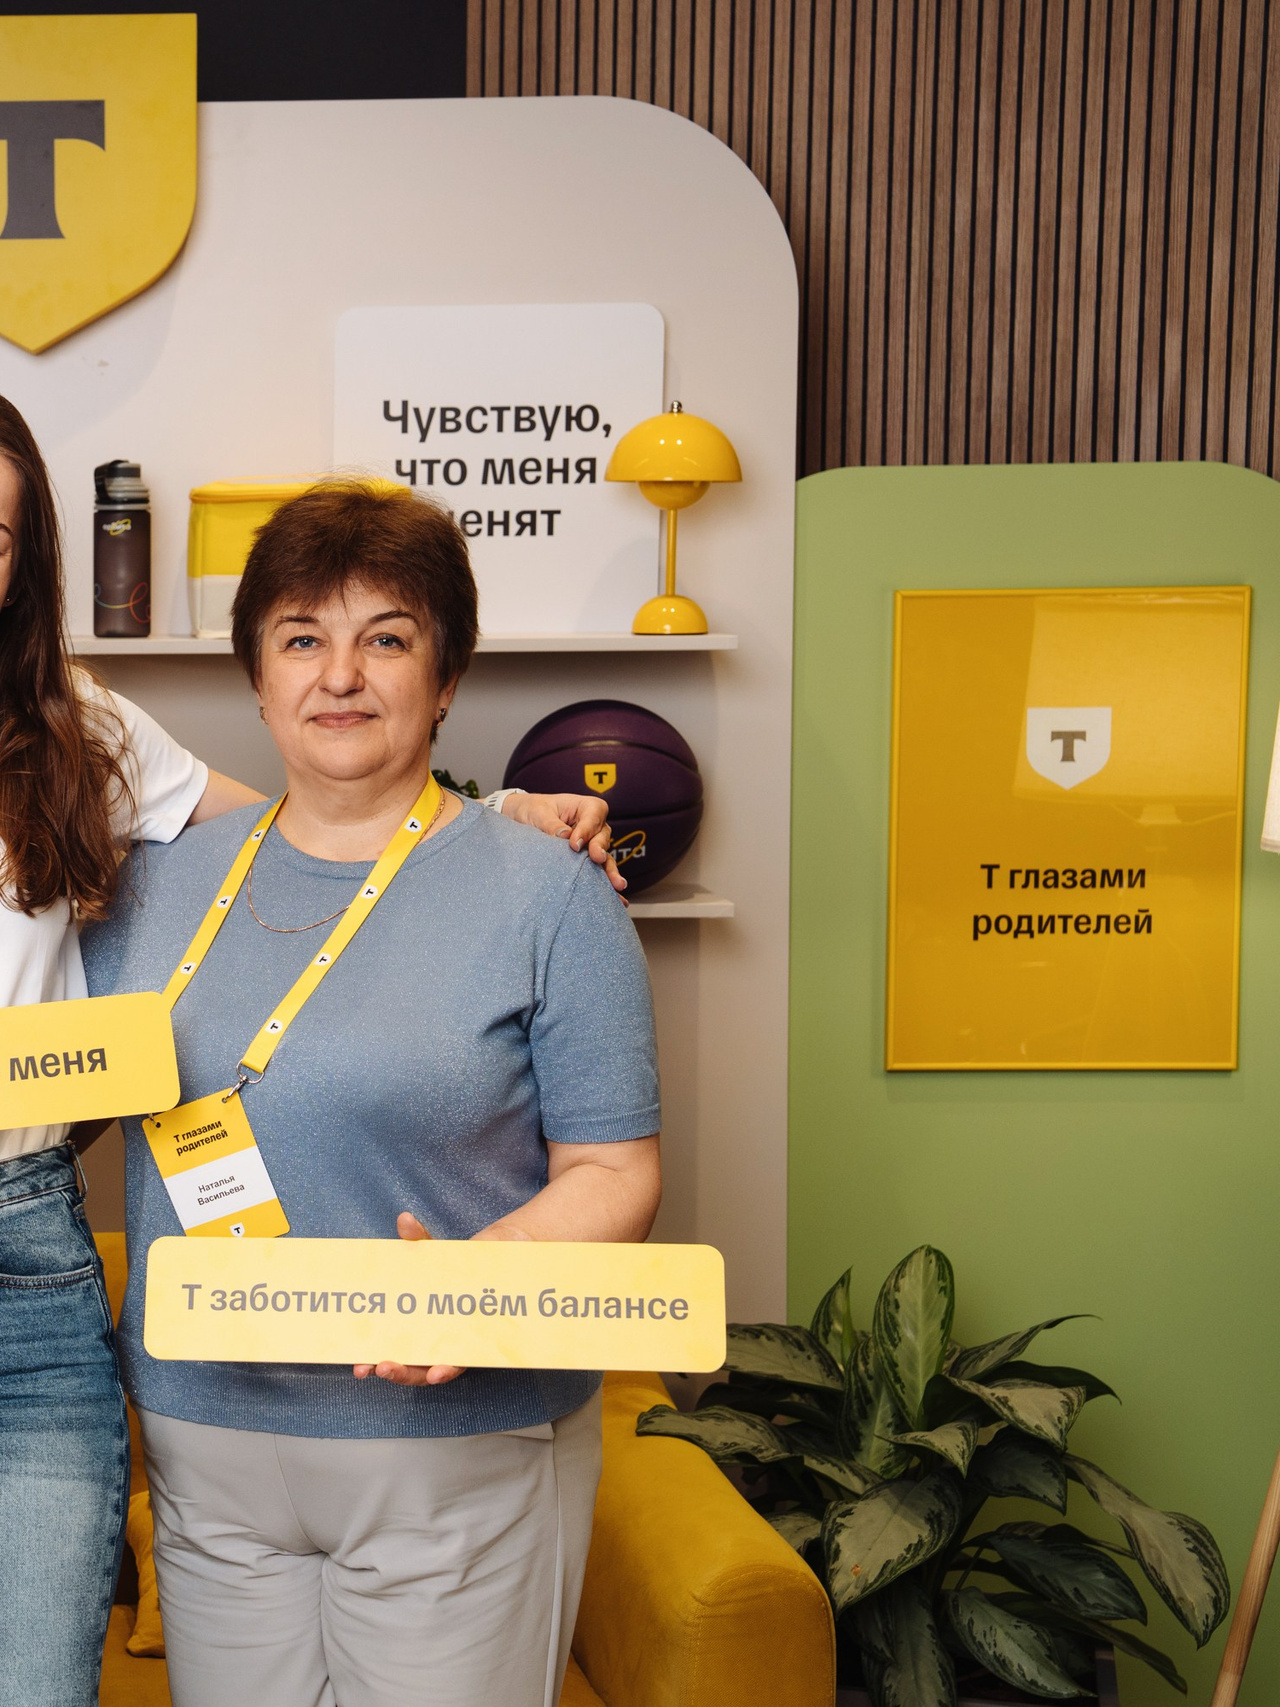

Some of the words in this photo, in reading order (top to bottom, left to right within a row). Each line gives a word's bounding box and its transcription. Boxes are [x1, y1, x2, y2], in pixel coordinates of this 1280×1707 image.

[383, 399, 612, 443] Чувствую,
[395, 458, 468, 486] что
[481, 457, 597, 486] меня
[448, 509, 562, 538] енят
[1050, 730, 1087, 763] Т
[593, 771, 608, 785] Т
[980, 863, 1001, 890] Т
[1009, 867, 1147, 890] глазами
[972, 908, 1153, 942] родителей
[9, 1047, 108, 1082] меня
[173, 1134, 180, 1143] Т
[181, 1120, 222, 1141] глазами
[176, 1129, 228, 1157] родителей
[197, 1184, 245, 1206] Васильева
[198, 1175, 236, 1194] Наталья
[181, 1283, 203, 1311] Т
[209, 1282, 386, 1314] заботится
[396, 1291, 417, 1315] о
[426, 1287, 528, 1318] моём
[537, 1287, 690, 1321] балансе
